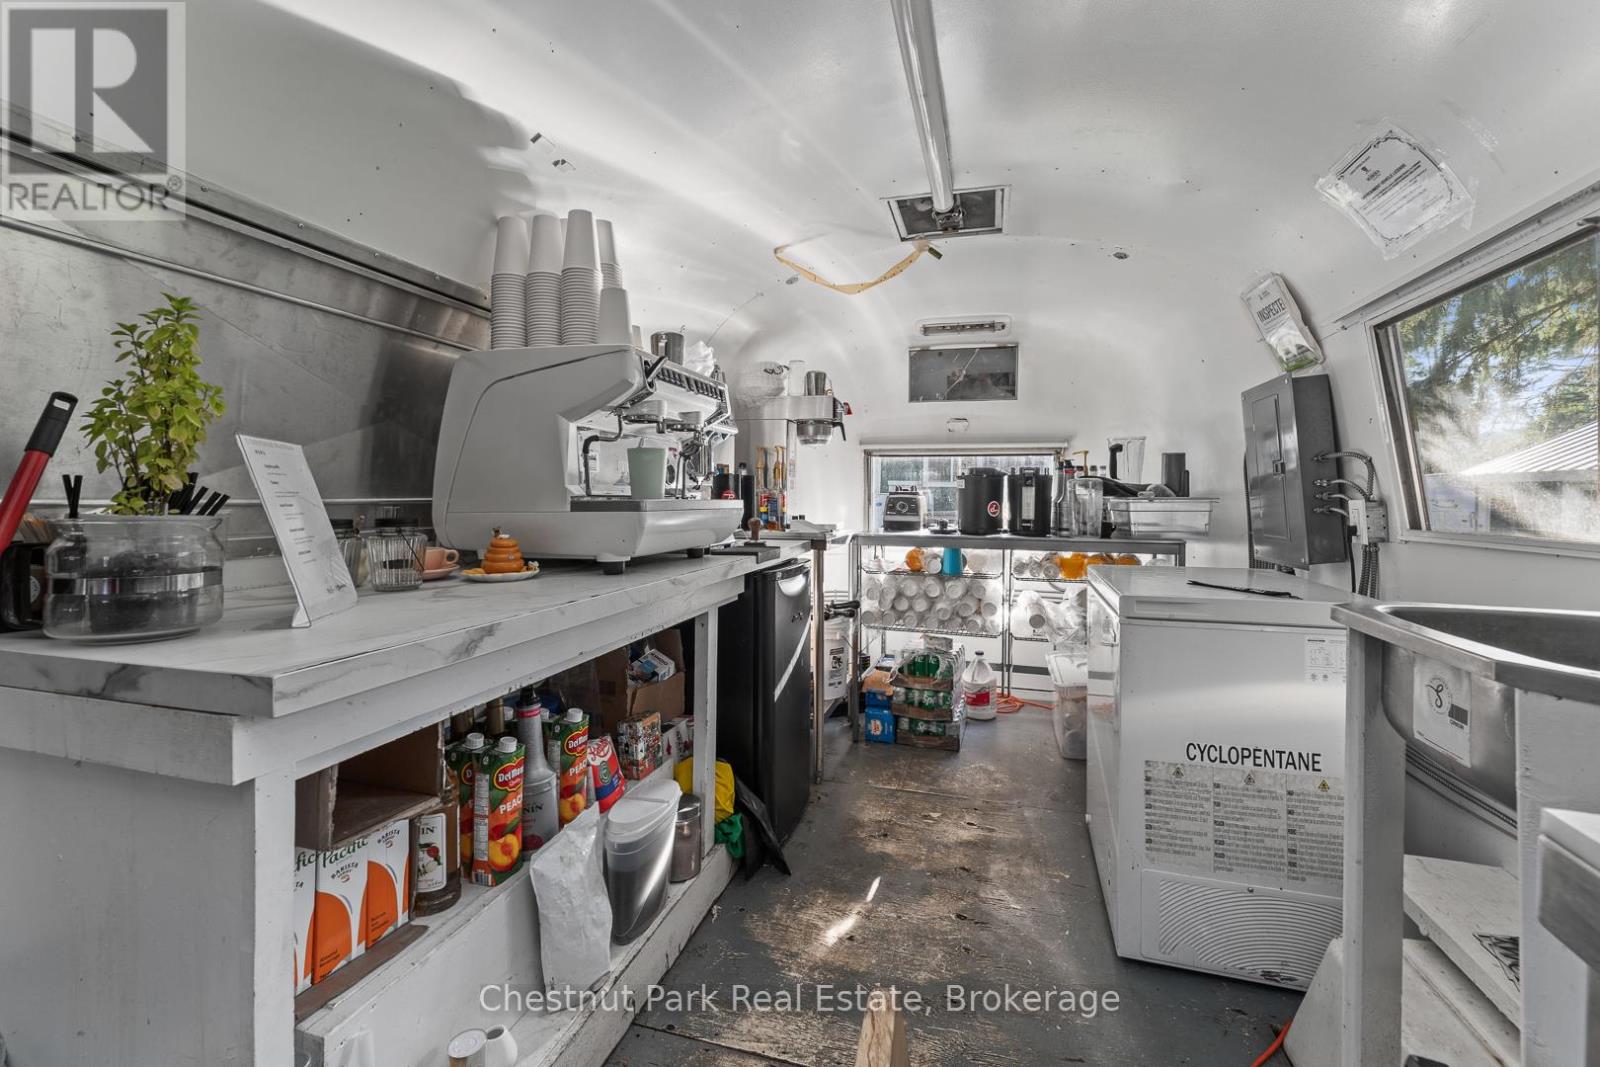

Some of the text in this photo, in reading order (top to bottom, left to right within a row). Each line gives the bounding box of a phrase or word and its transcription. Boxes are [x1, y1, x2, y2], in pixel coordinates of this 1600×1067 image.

[1257, 298, 1286, 323] INSPECTE
[569, 760, 588, 776] PEAC
[1186, 743, 1322, 772] CYCLOPENTANE
[499, 794, 523, 814] PEAC
